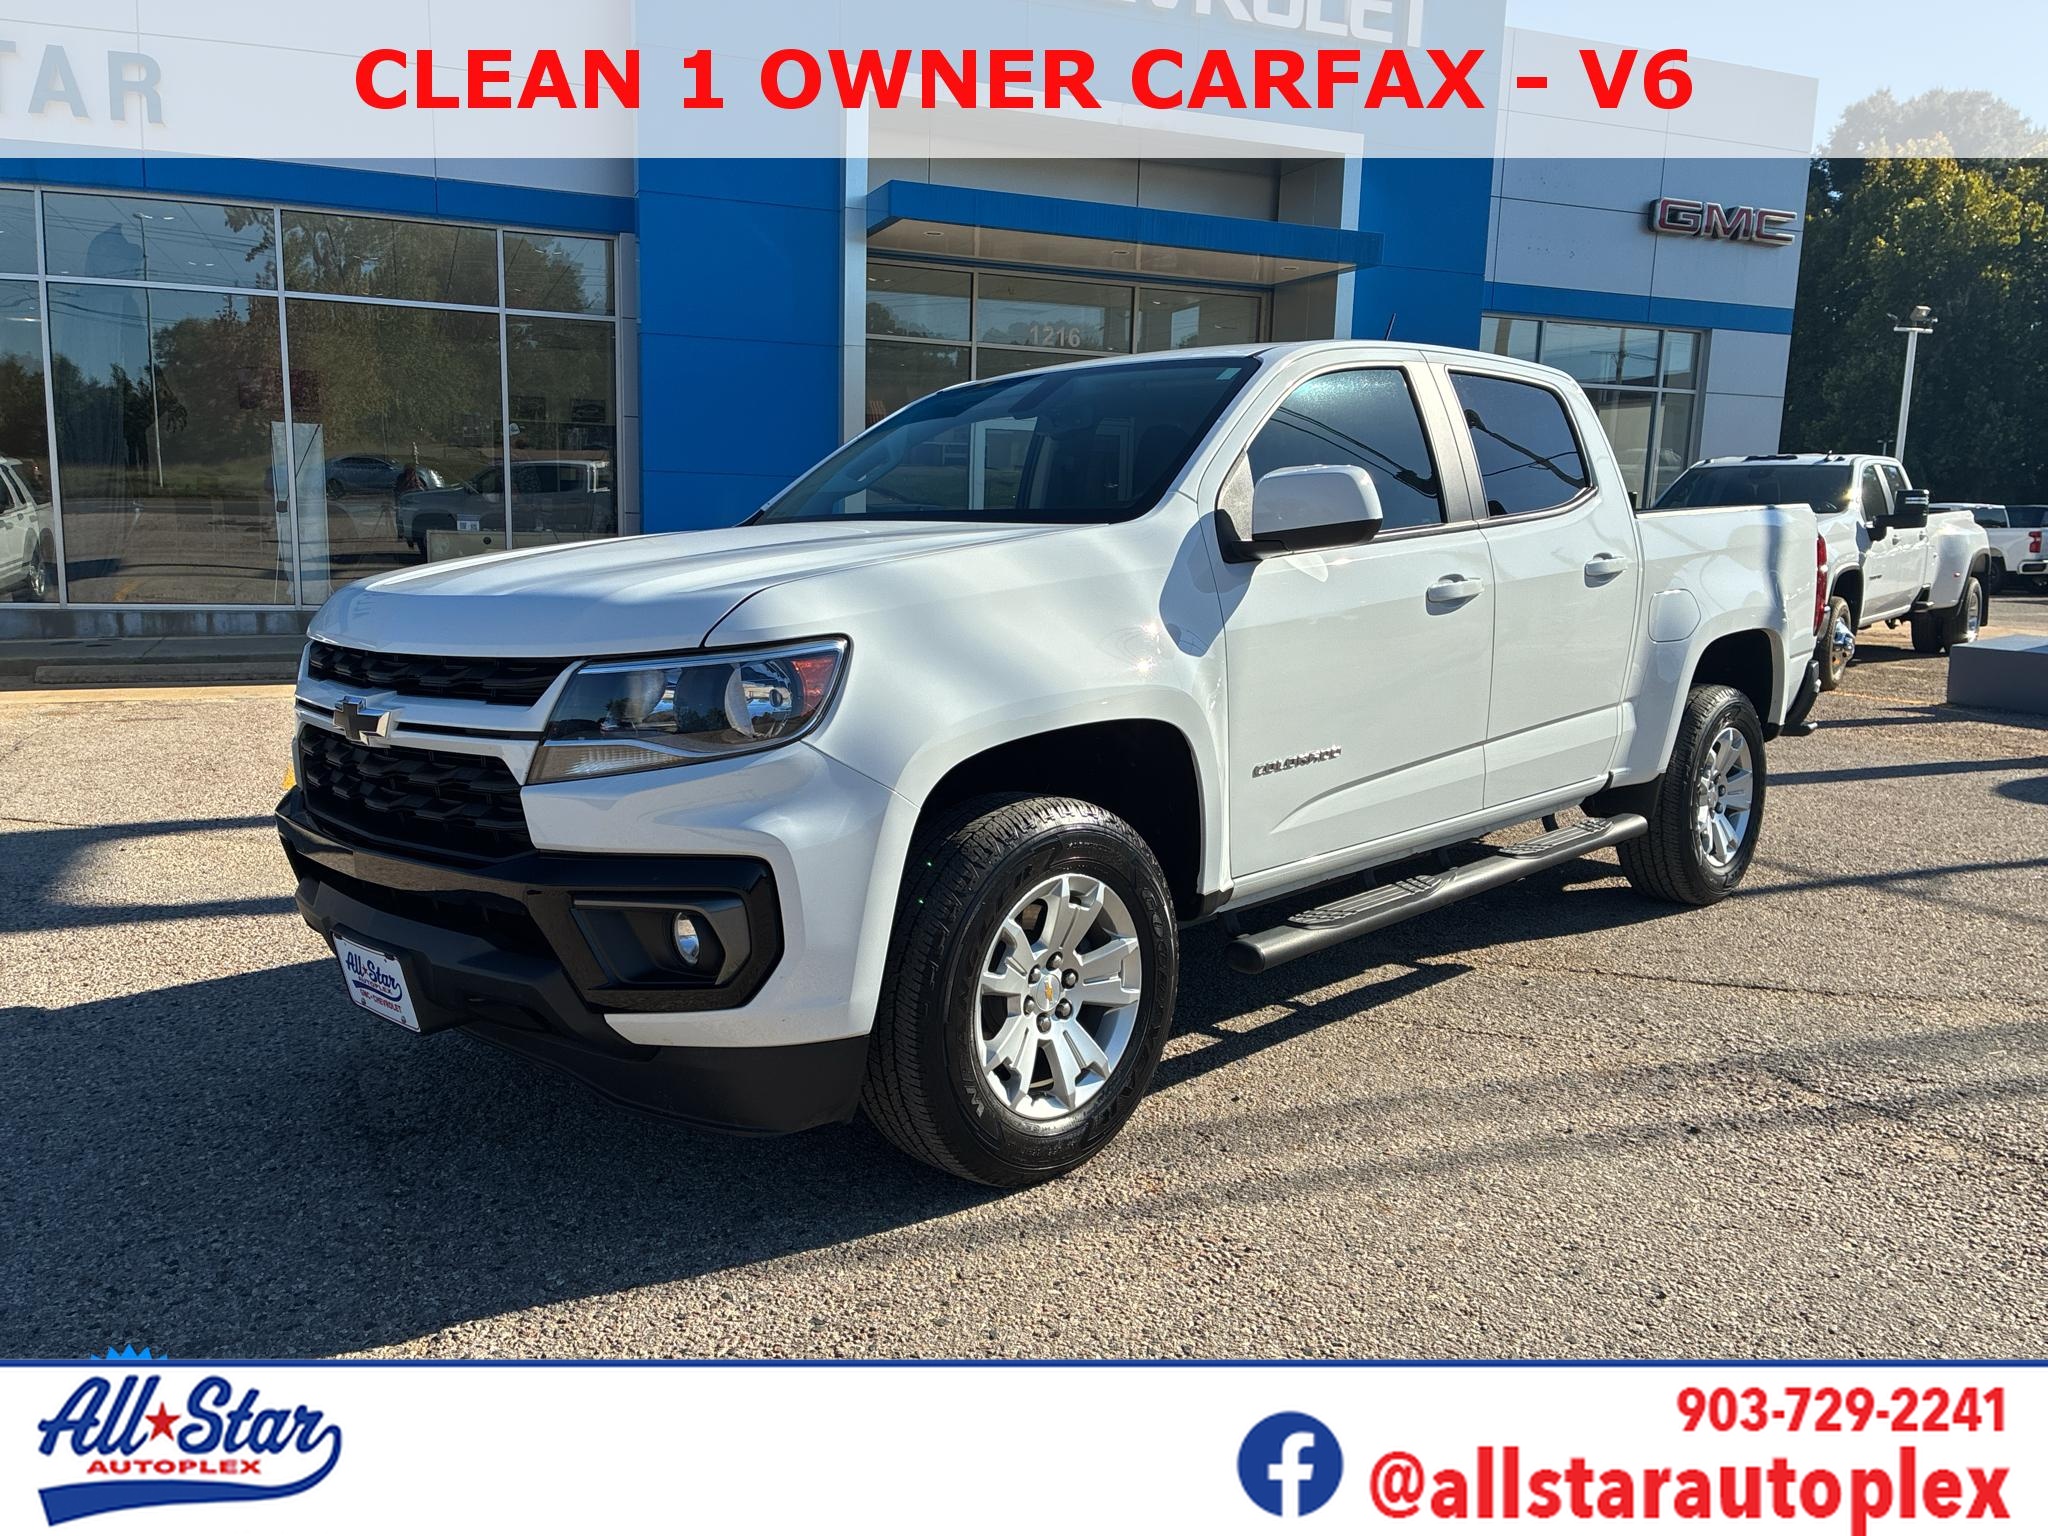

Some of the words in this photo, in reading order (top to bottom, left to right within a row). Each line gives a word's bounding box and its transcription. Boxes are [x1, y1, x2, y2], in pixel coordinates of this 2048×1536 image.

[0, 39, 163, 124] AR
[1650, 197, 1797, 246] GMC
[1030, 325, 1080, 347] 1216
